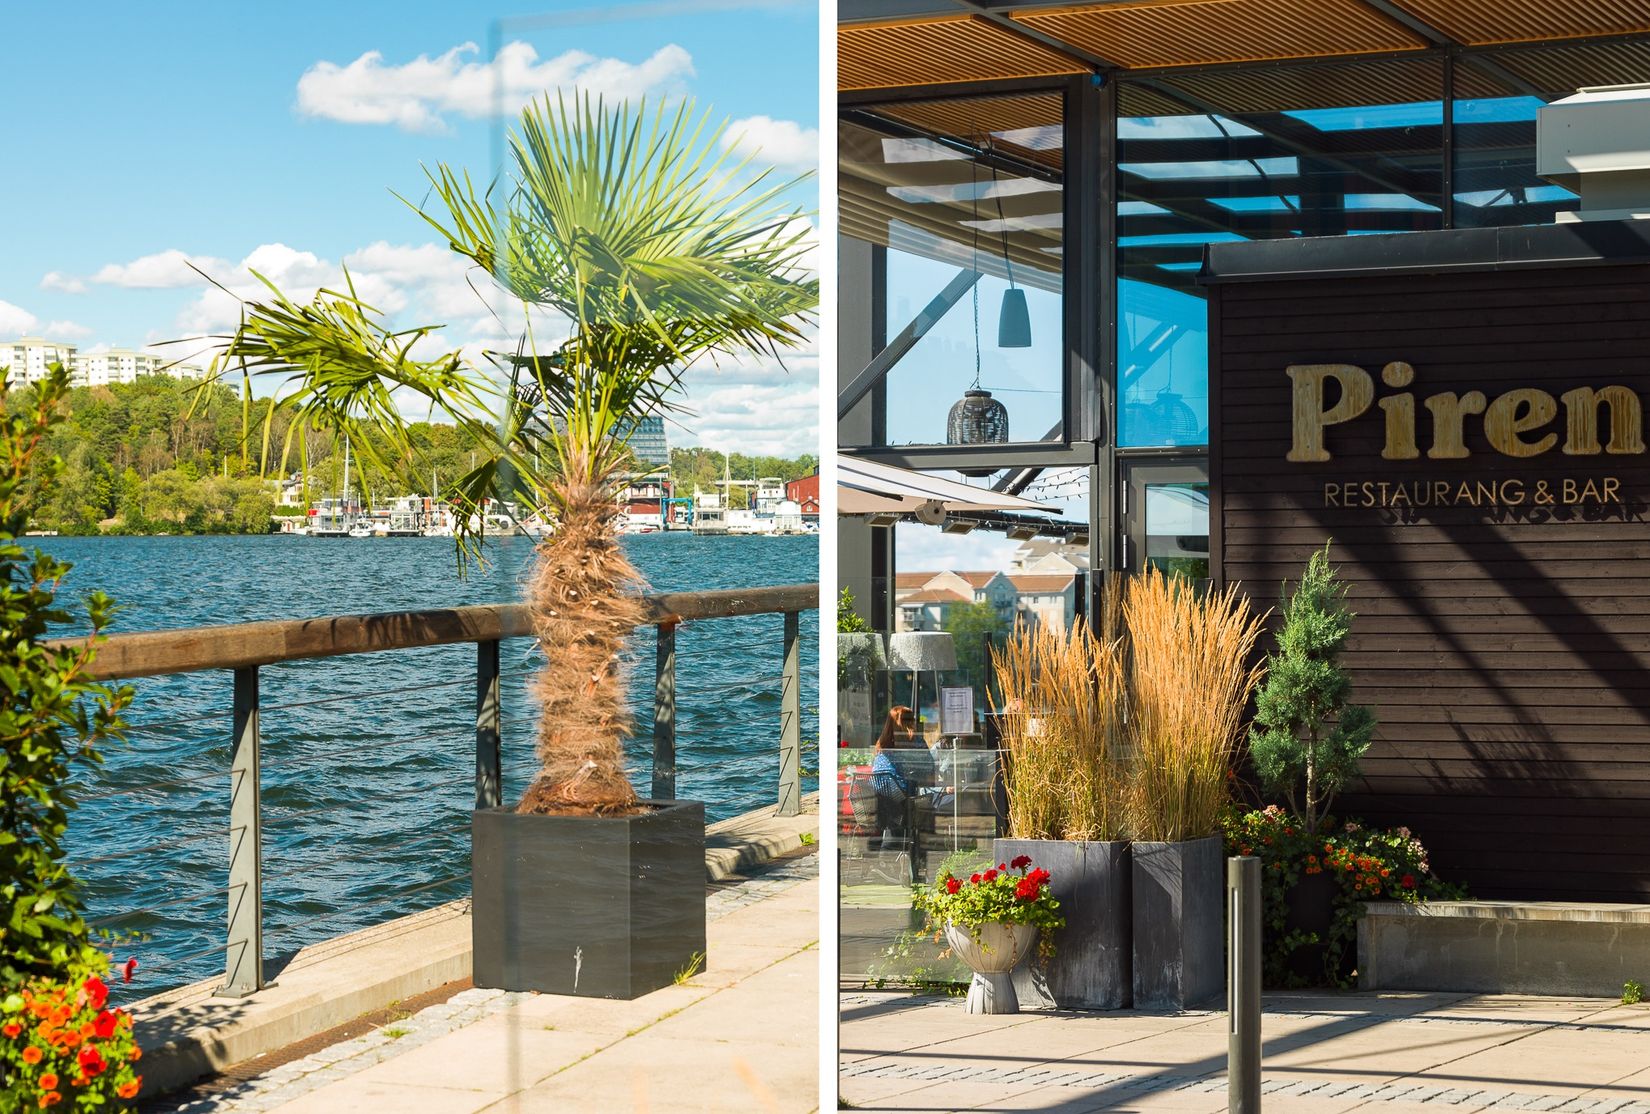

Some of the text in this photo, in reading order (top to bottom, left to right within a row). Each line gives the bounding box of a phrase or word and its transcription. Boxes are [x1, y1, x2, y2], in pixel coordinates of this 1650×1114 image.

[1286, 361, 1646, 462] Piren
[1324, 477, 1621, 507] RESTAURANG & BAR
